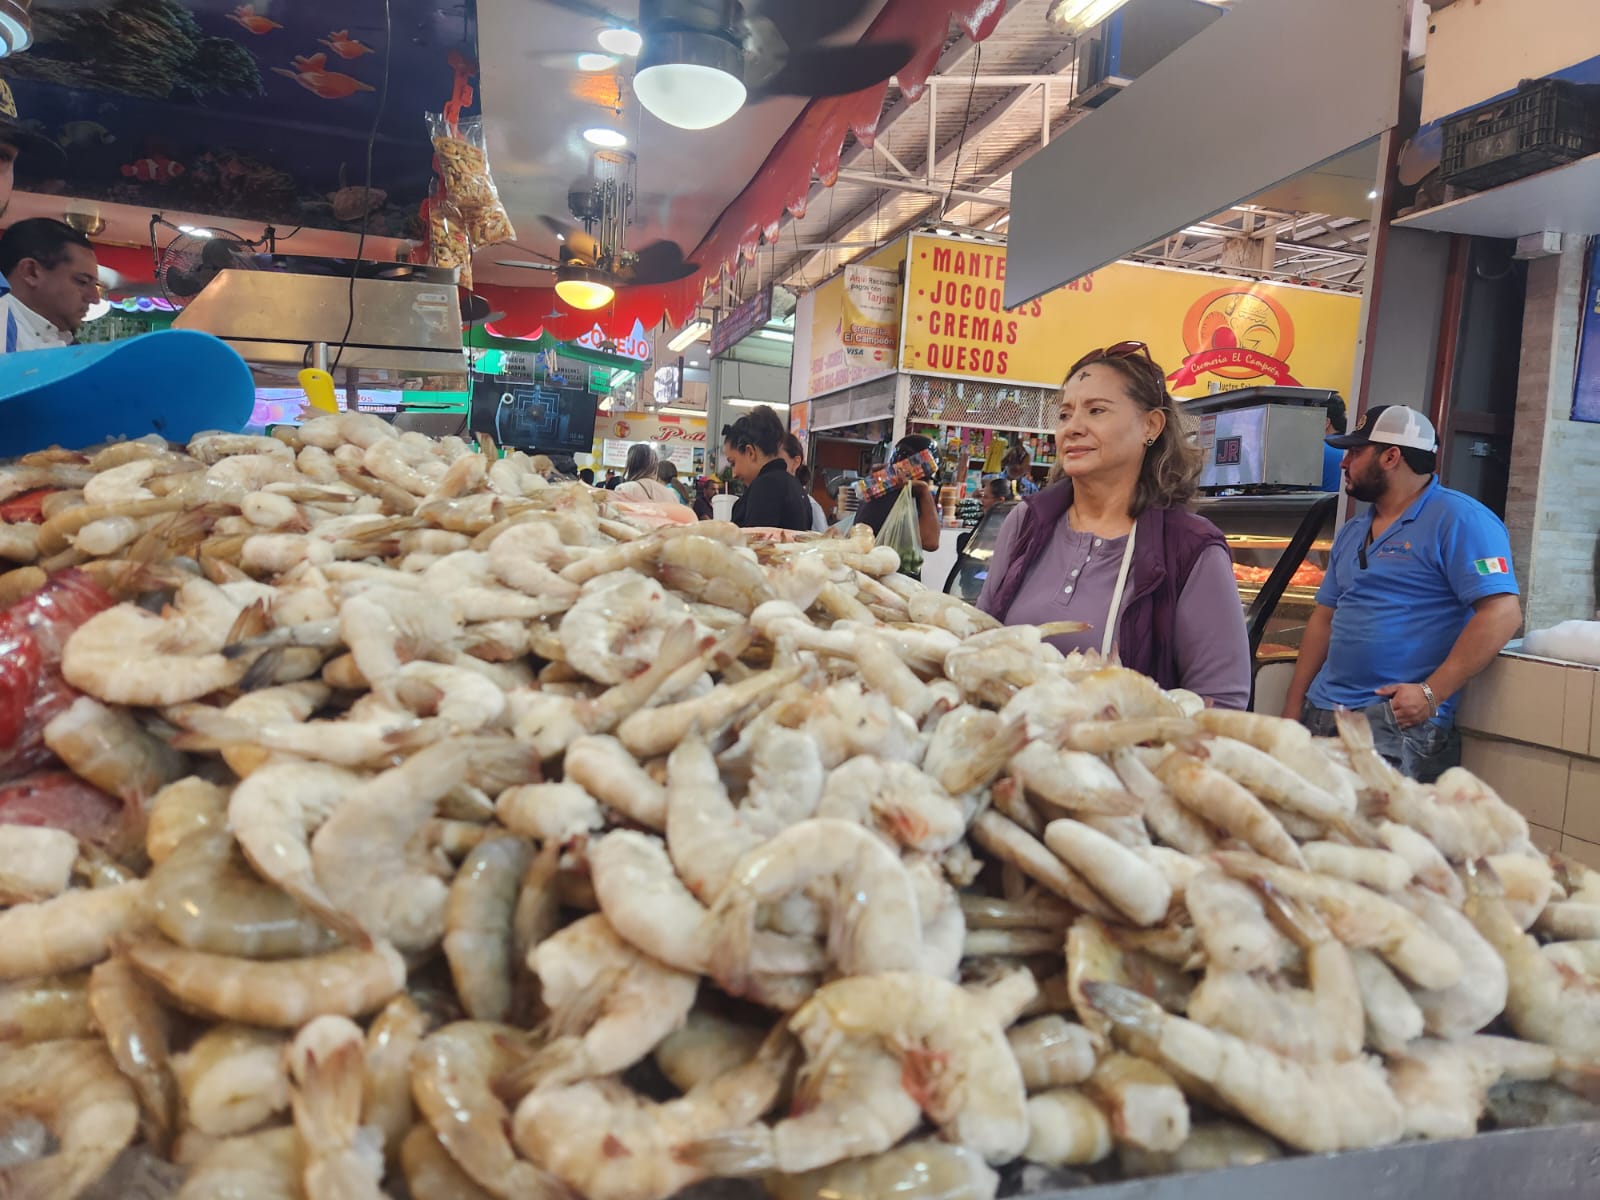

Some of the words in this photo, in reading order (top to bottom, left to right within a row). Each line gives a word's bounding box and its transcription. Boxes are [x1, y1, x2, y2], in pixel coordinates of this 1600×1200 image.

[930, 280, 1042, 317] JOCOQS
[929, 310, 1018, 344] CREMAS
[927, 343, 1008, 375] QUESOS
[1231, 352, 1241, 362] El
